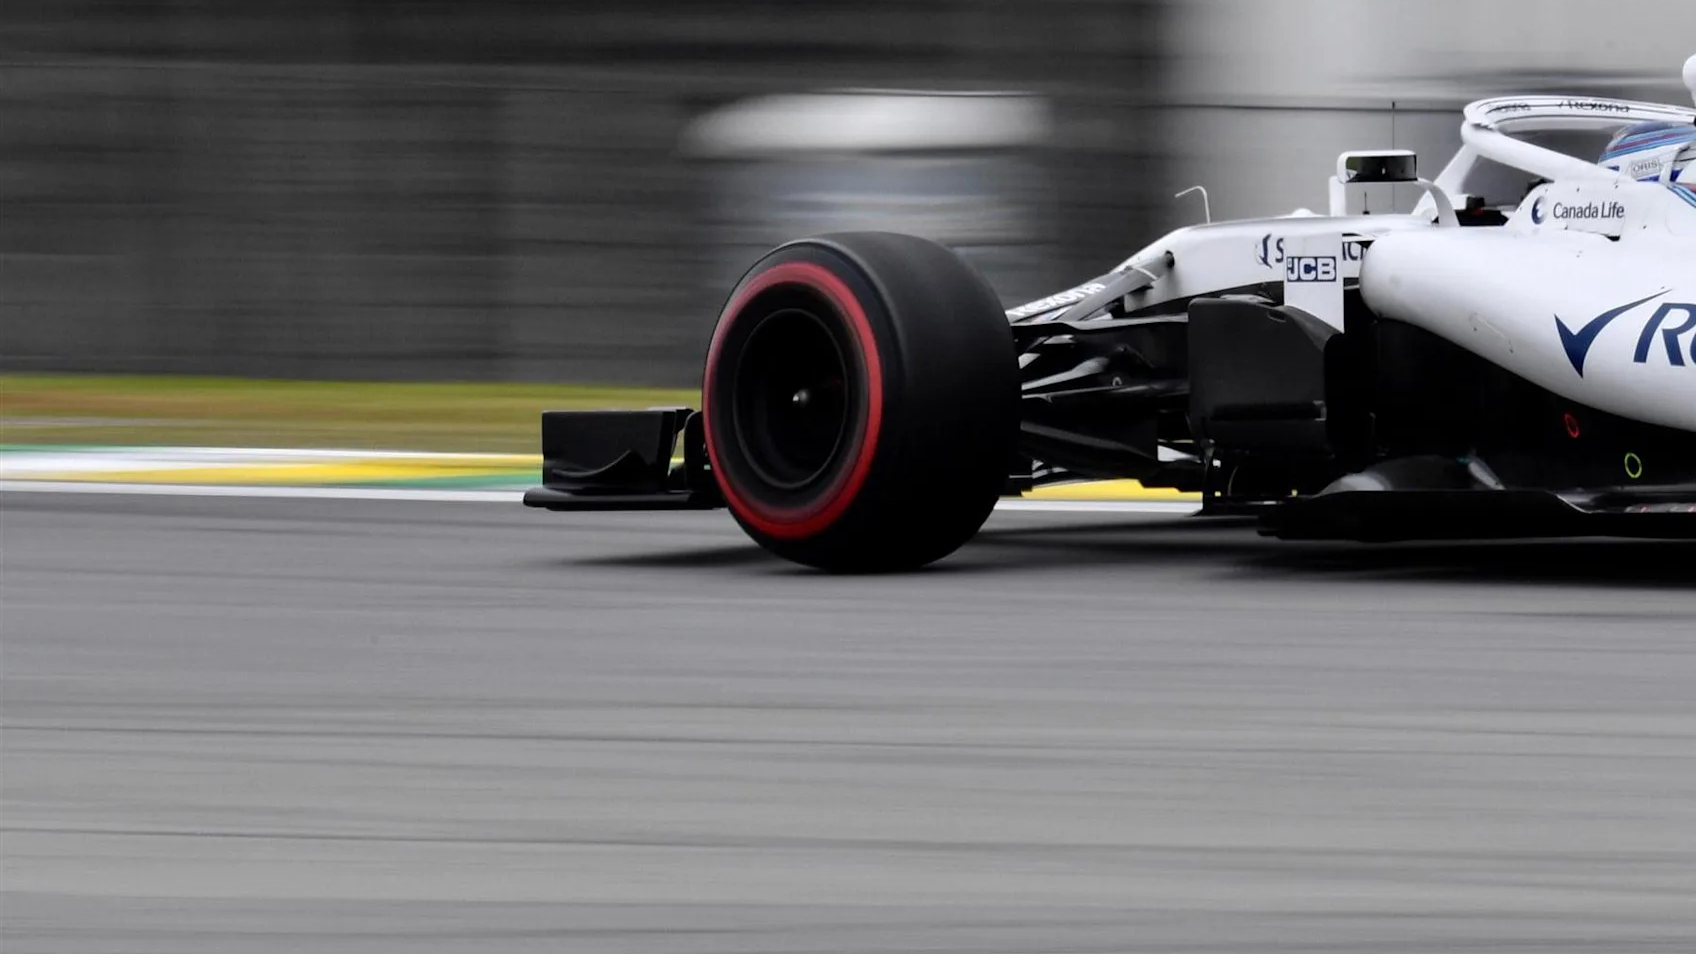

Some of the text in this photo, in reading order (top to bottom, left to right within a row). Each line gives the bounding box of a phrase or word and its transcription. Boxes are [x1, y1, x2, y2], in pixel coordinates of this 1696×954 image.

[1553, 201, 1625, 219] Canada Life
[1287, 257, 1336, 281] JCB
